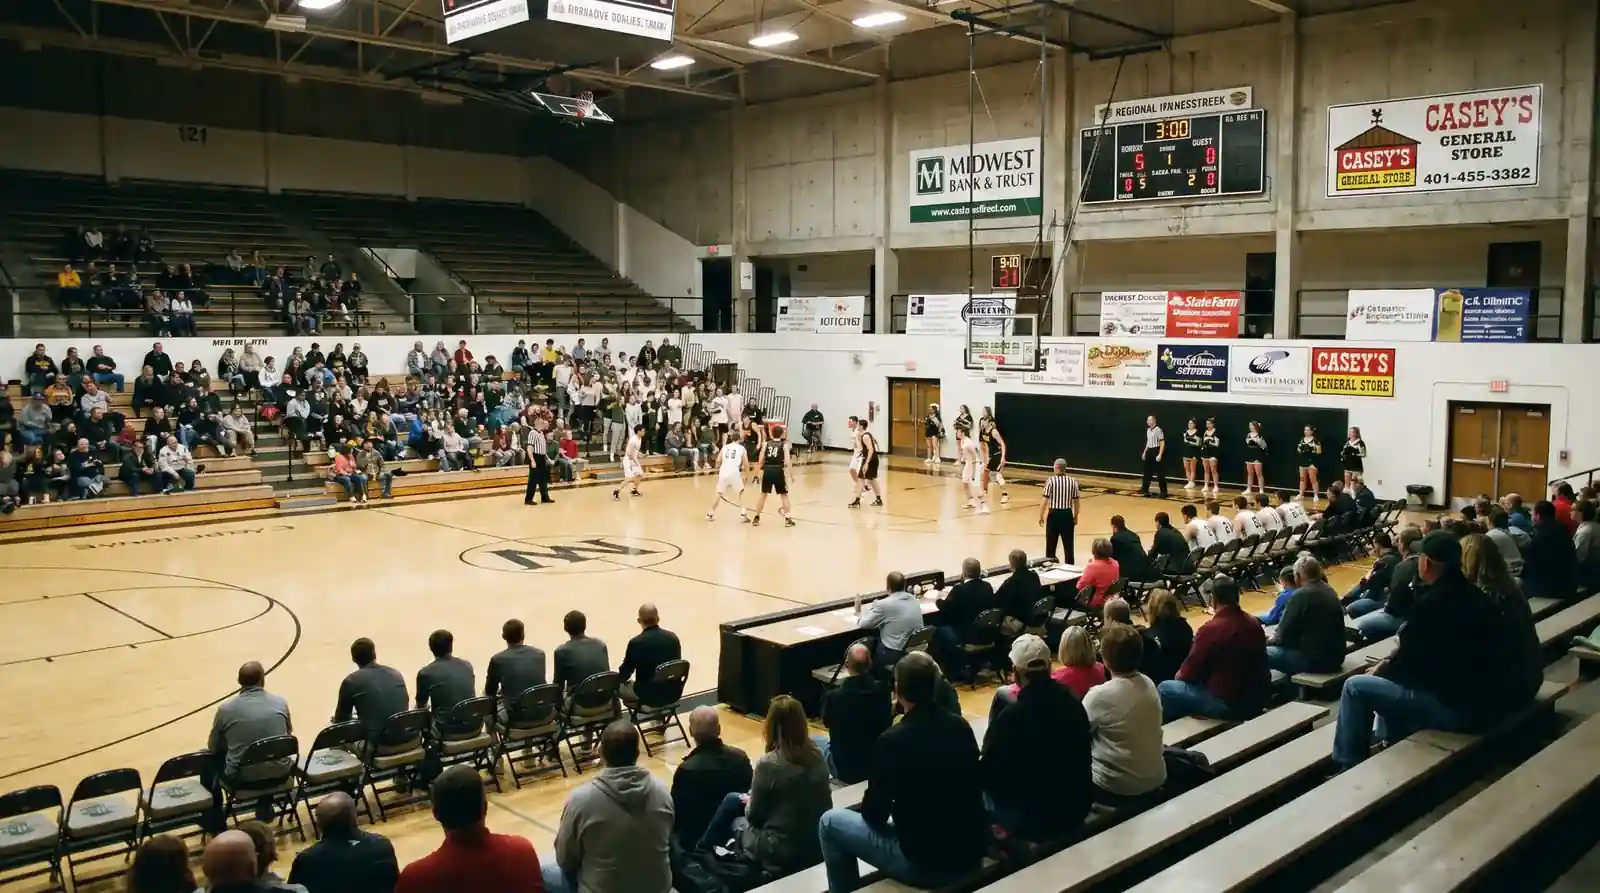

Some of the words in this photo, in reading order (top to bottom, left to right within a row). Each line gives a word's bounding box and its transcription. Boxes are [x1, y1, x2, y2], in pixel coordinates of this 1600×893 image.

[1115, 103, 1158, 117] REGIONAL
[1425, 94, 1533, 132] CASEY'S
[1156, 120, 1189, 139] 3:00
[1440, 130, 1516, 147] GENERAL
[1167, 152, 1172, 165] 1
[1205, 147, 1216, 164] 0
[1342, 148, 1411, 170] CASEY'S
[1451, 146, 1504, 161] STORE
[950, 149, 1035, 177] MIDWEST
[919, 161, 942, 190] M
[949, 178, 980, 193] BANK
[984, 177, 993, 190] &
[996, 172, 1034, 188] TRUST
[1139, 177, 1147, 189] 5
[1188, 174, 1196, 186] 2
[1341, 175, 1381, 186] GENERAL
[1382, 172, 1411, 184] STORE
[1423, 167, 1531, 185] 401-455-3382
[1317, 352, 1389, 374] CASEY'S
[1315, 378, 1357, 391] GENERAL
[1360, 379, 1390, 392] STORE
[767, 446, 778, 458] 34
